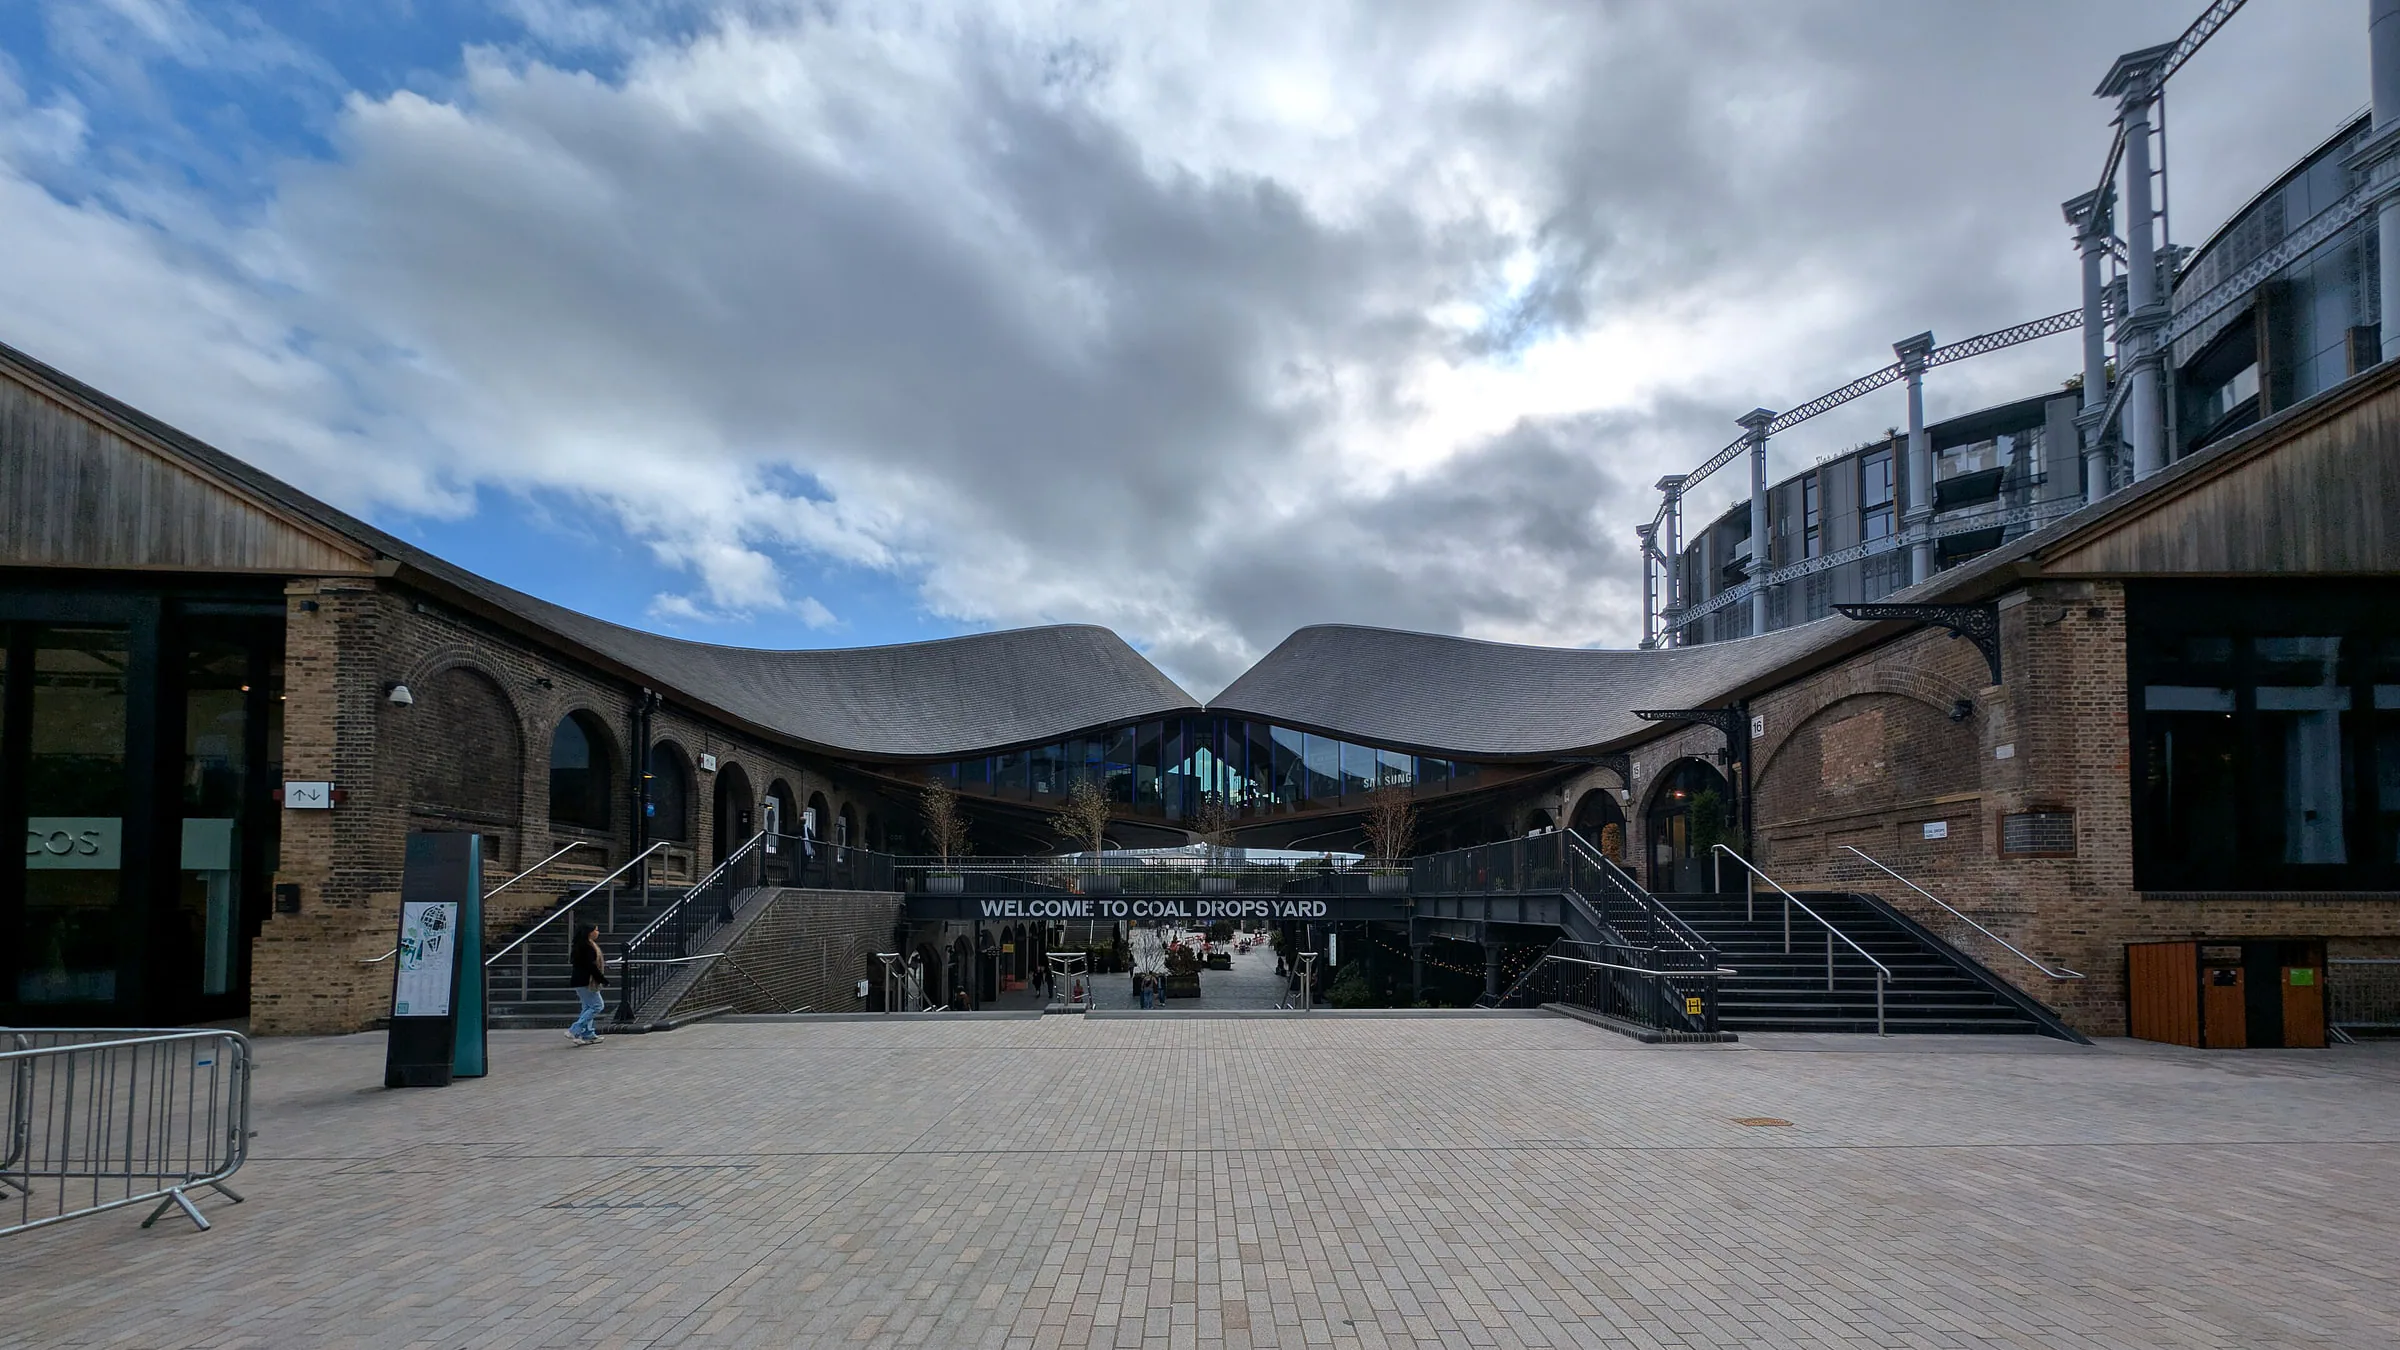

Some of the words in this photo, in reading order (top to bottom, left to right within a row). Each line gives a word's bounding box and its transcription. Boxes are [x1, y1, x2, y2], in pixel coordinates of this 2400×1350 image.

[1753, 721, 1762, 733] 16
[980, 900, 1094, 917] WELCOME
[1099, 900, 1129, 917] TO
[1132, 900, 1191, 917] COAL
[1196, 900, 1269, 917] DROPS
[1271, 900, 1327, 917] YARD
